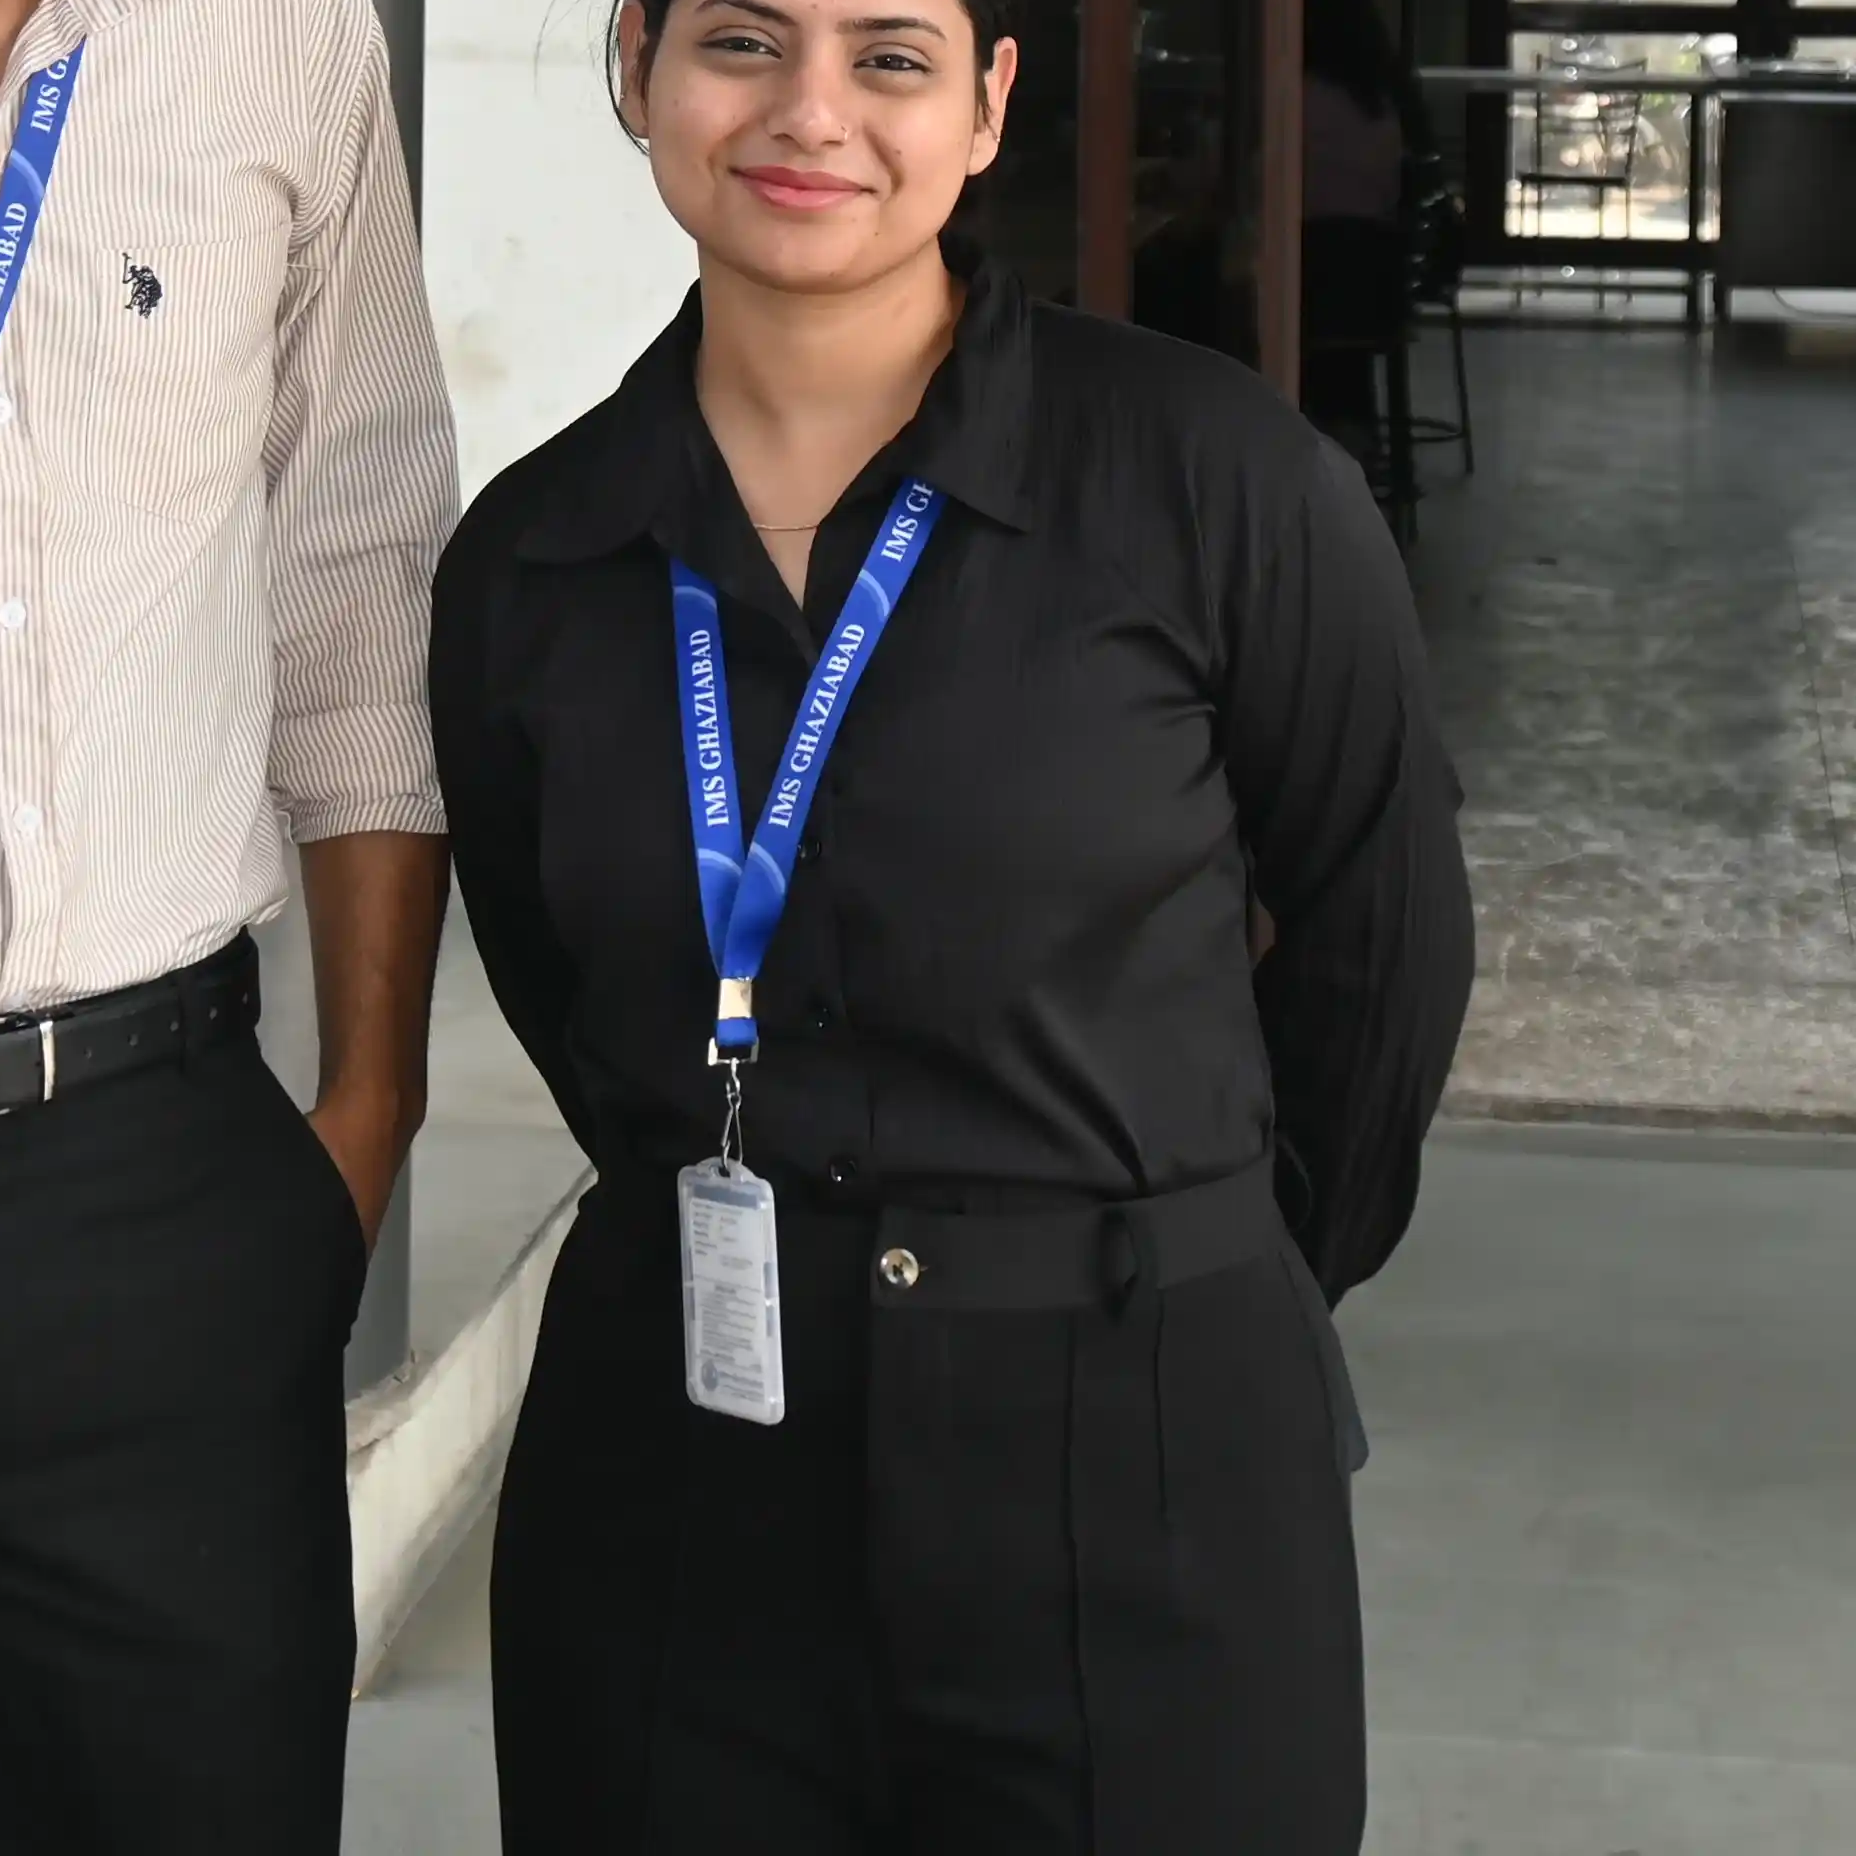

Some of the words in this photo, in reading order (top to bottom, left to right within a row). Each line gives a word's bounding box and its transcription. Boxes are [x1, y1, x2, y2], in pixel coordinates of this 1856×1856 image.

[30, 84, 61, 134] IMS
[46, 56, 70, 80] G
[880, 514, 919, 562] IMS
[689, 629, 723, 771] GHAZIABAD
[768, 777, 803, 829] IMS
[790, 622, 866, 775] GHAZIABAD
[703, 776, 730, 828] IMS
